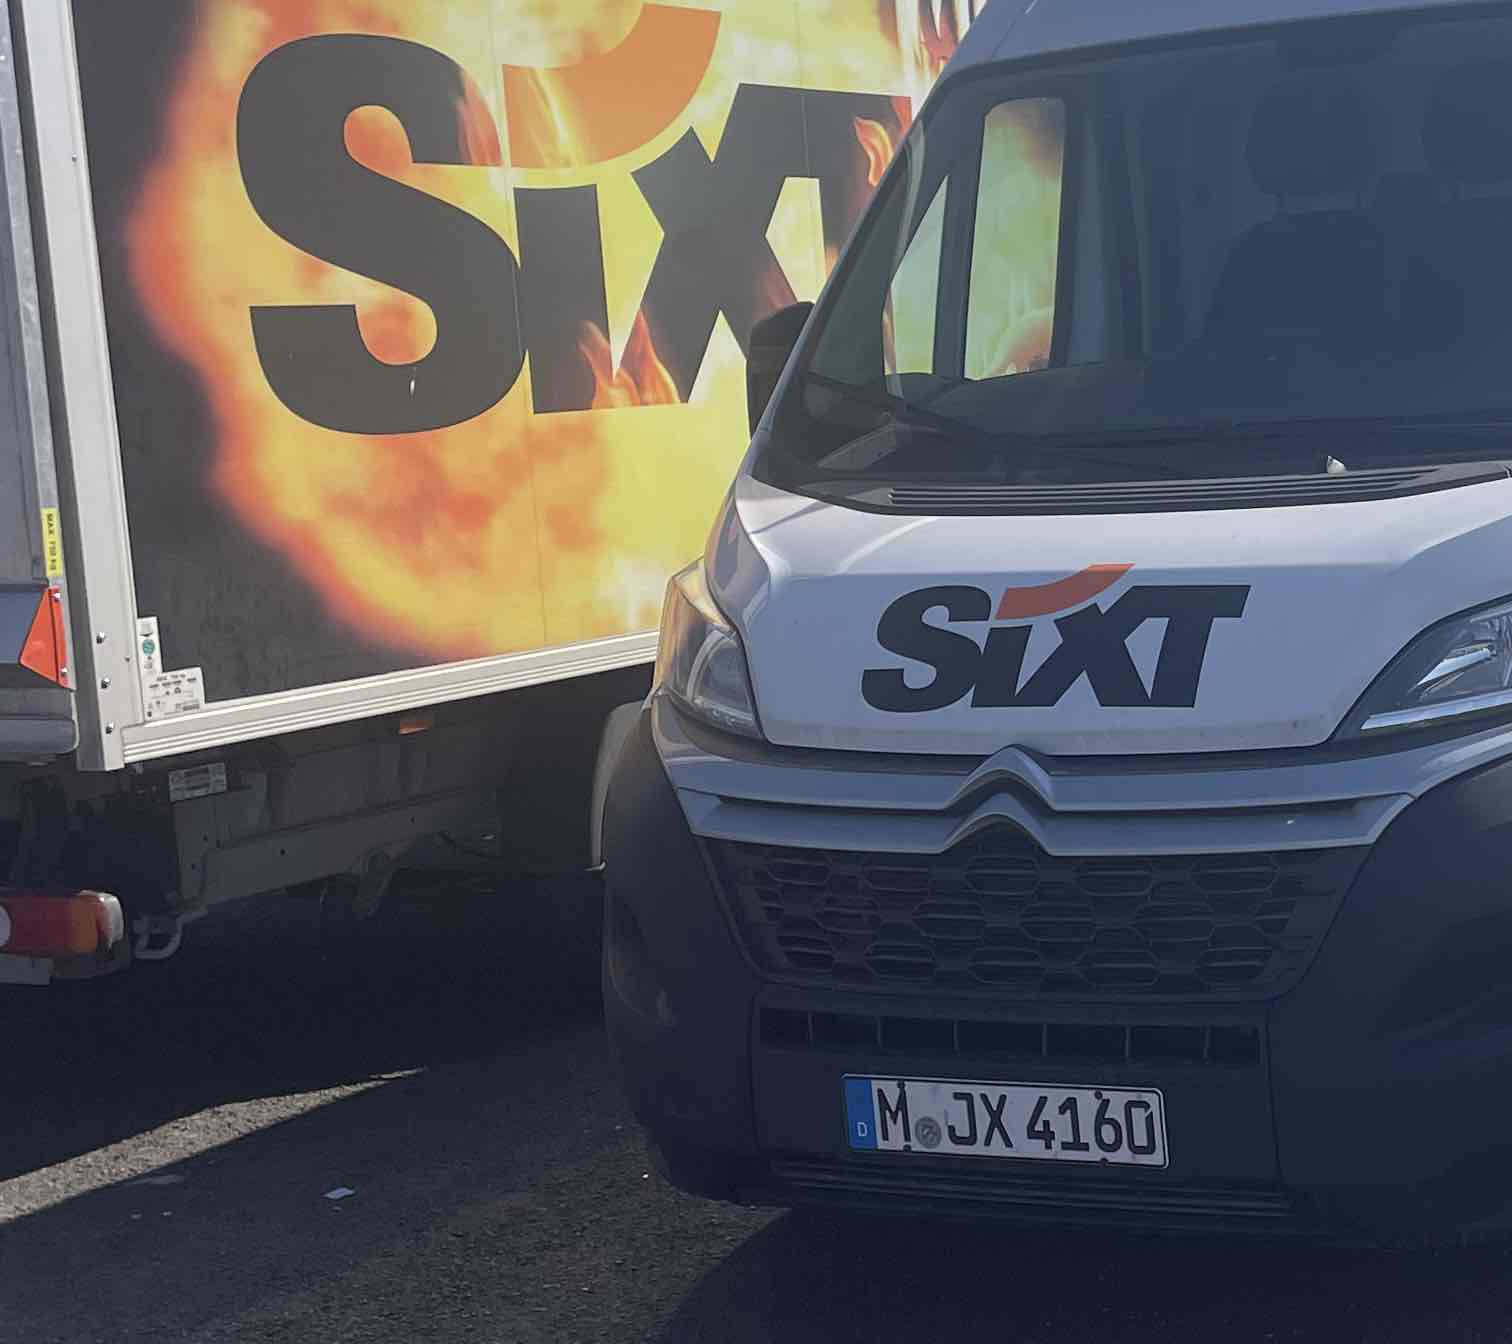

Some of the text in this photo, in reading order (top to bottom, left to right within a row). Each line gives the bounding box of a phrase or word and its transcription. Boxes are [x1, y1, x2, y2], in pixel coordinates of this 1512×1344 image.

[857, 1087, 1157, 1155] D M JX 4160
